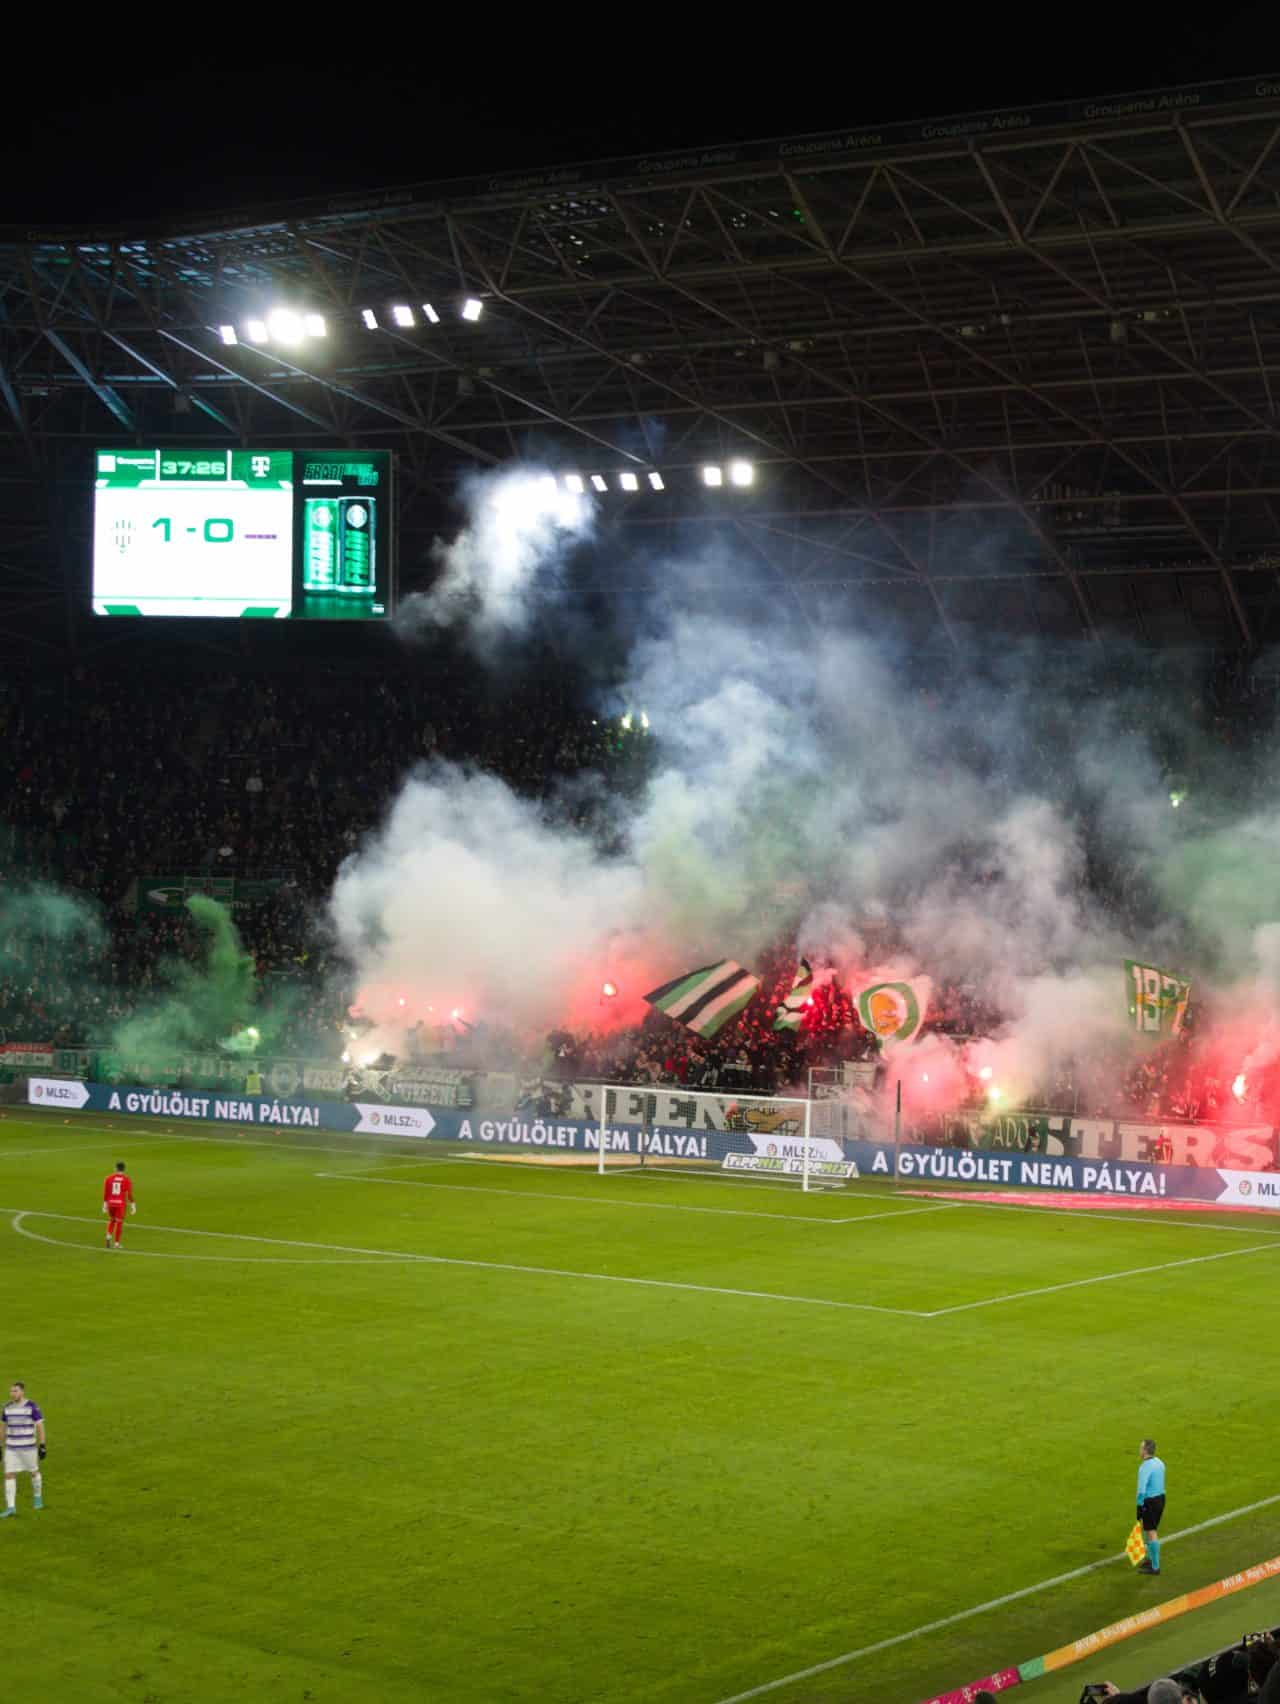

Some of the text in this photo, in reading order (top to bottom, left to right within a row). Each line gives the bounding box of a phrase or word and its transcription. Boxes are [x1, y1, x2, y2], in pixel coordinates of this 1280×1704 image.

[162, 460, 225, 475] 37:26
[108, 1090, 320, 1127] A GYŰLÖLET NEM PÁLYA!
[458, 1120, 473, 1139] A
[479, 1117, 578, 1147] GYŰLÖLET
[584, 1128, 630, 1151] NEM
[871, 1147, 1166, 1195] A GYŰLÖLET NEM PÁLYA!
